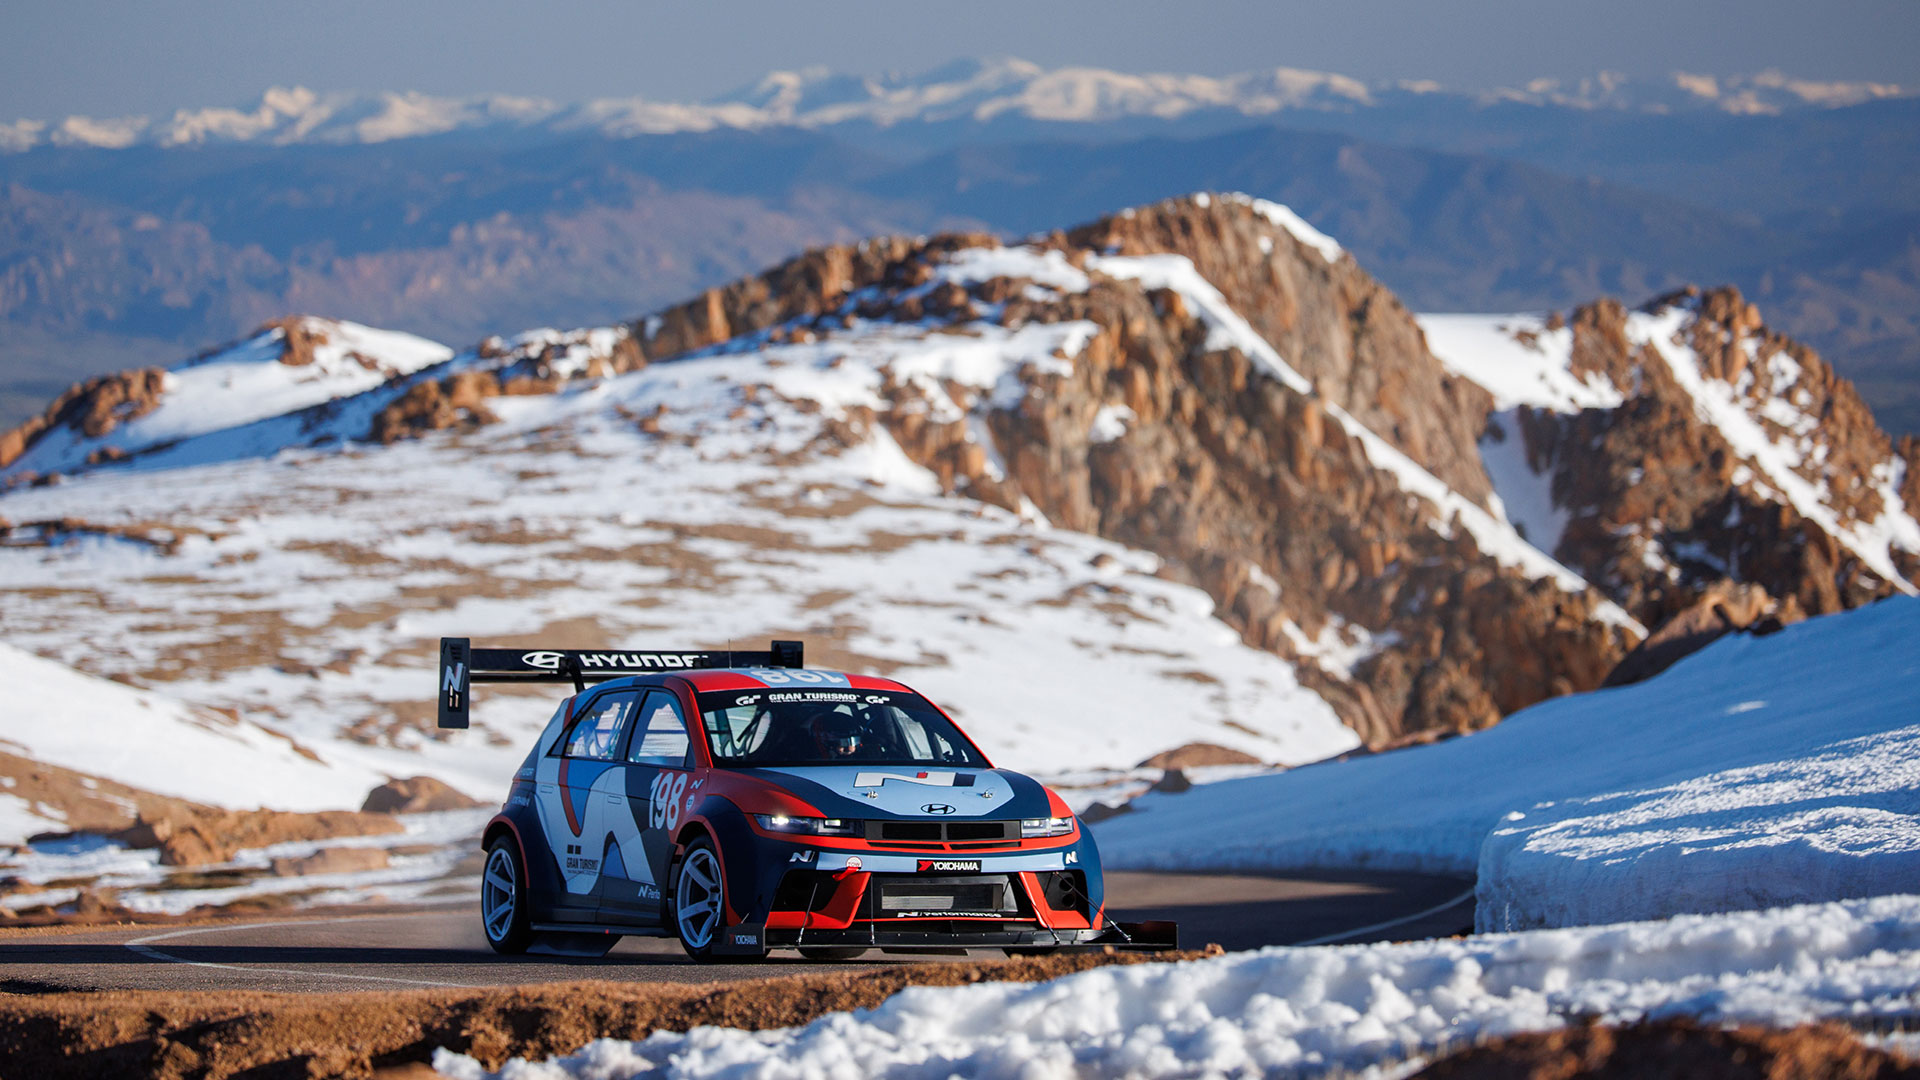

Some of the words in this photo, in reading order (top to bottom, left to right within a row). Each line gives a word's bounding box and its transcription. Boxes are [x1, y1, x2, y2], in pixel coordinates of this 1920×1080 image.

[579, 654, 708, 668] HYUNDA
[768, 693, 802, 701] GRAN
[649, 772, 687, 830] 198
[567, 857, 579, 869] GRAN
[933, 862, 979, 871] YOKOHAMA
[735, 935, 757, 945] YOKOHAMA
